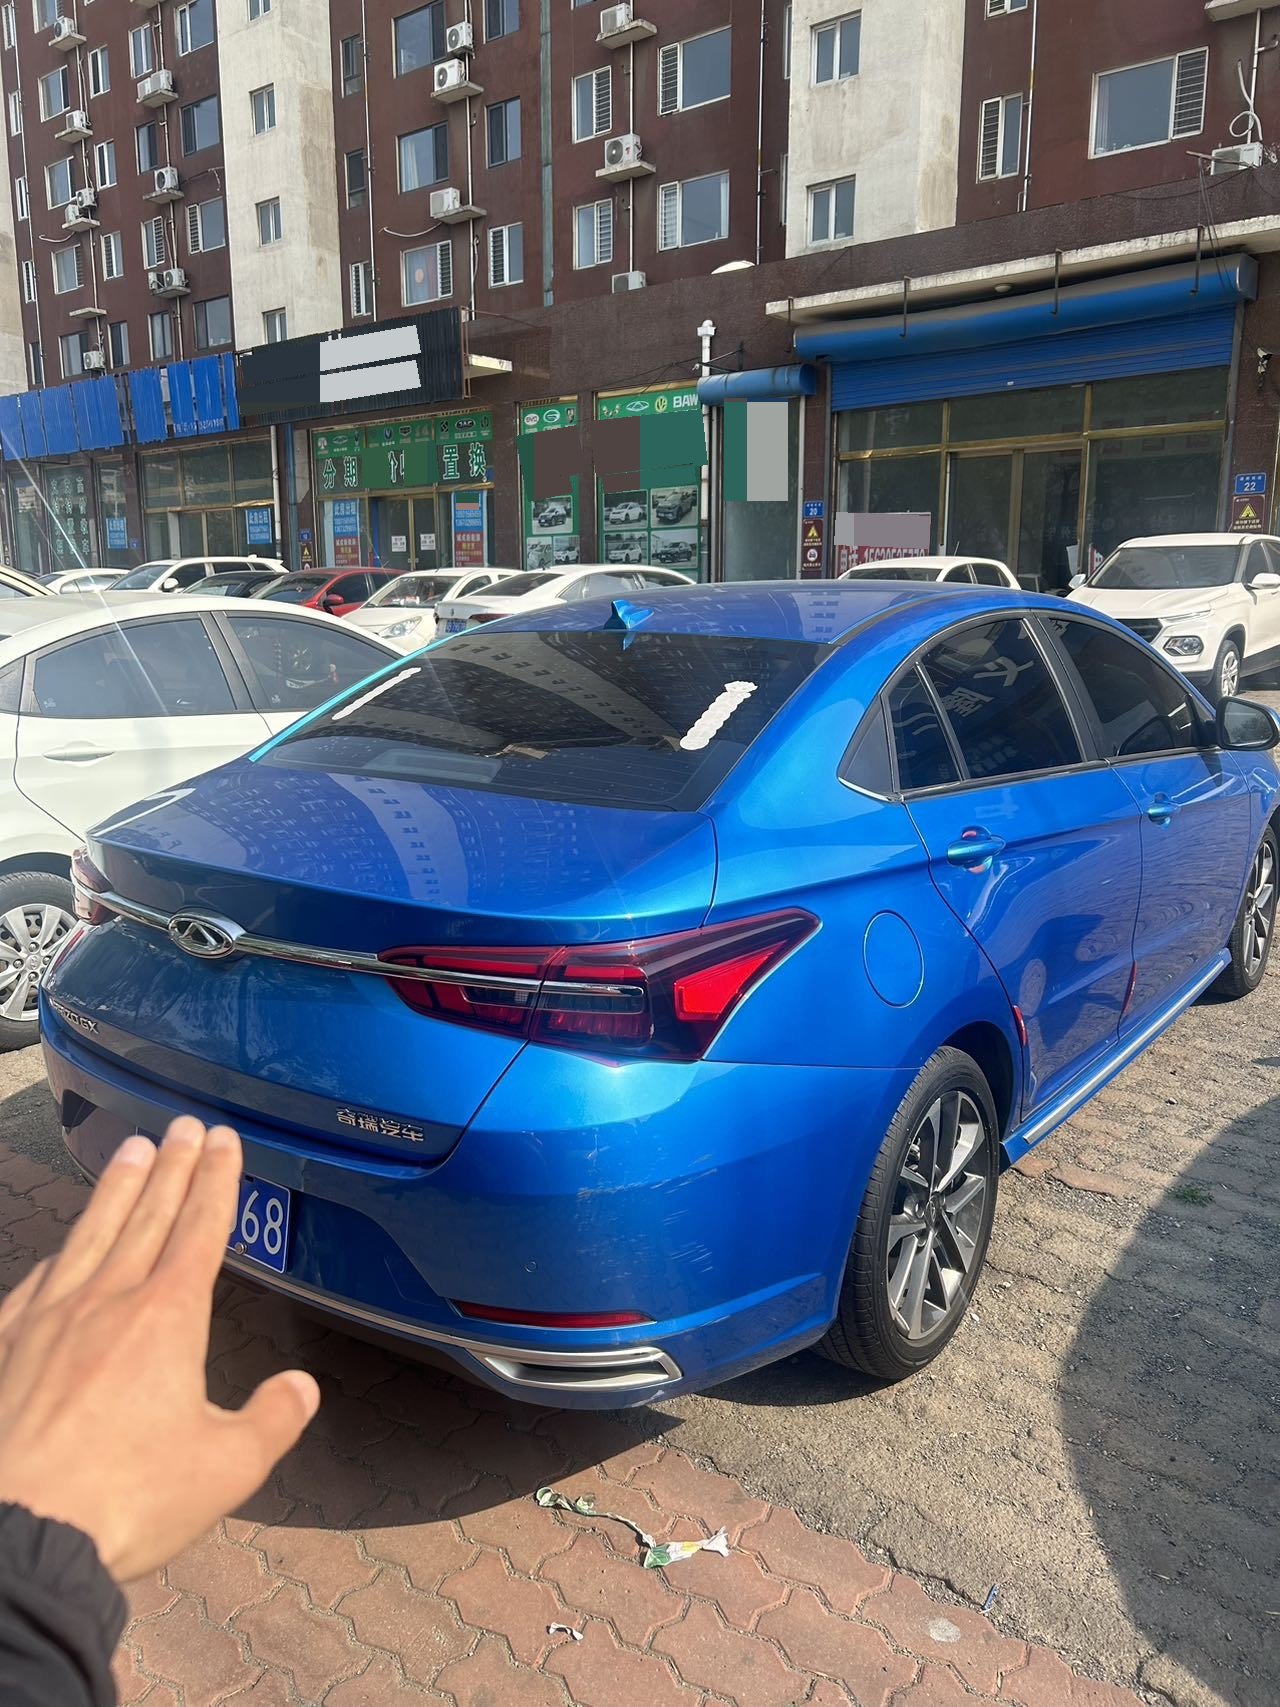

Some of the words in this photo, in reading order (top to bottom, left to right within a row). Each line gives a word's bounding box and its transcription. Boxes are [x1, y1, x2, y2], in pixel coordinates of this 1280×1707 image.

[673, 394, 698, 408] BAW
[323, 455, 358, 490] 分期
[443, 442, 488, 483] 置换
[1243, 482, 1256, 491] 22
[809, 507, 818, 516] 20
[79, 1017, 99, 1034] GX
[336, 1108, 424, 1142] 奇瑞汽车
[233, 1188, 284, 1256] 68
